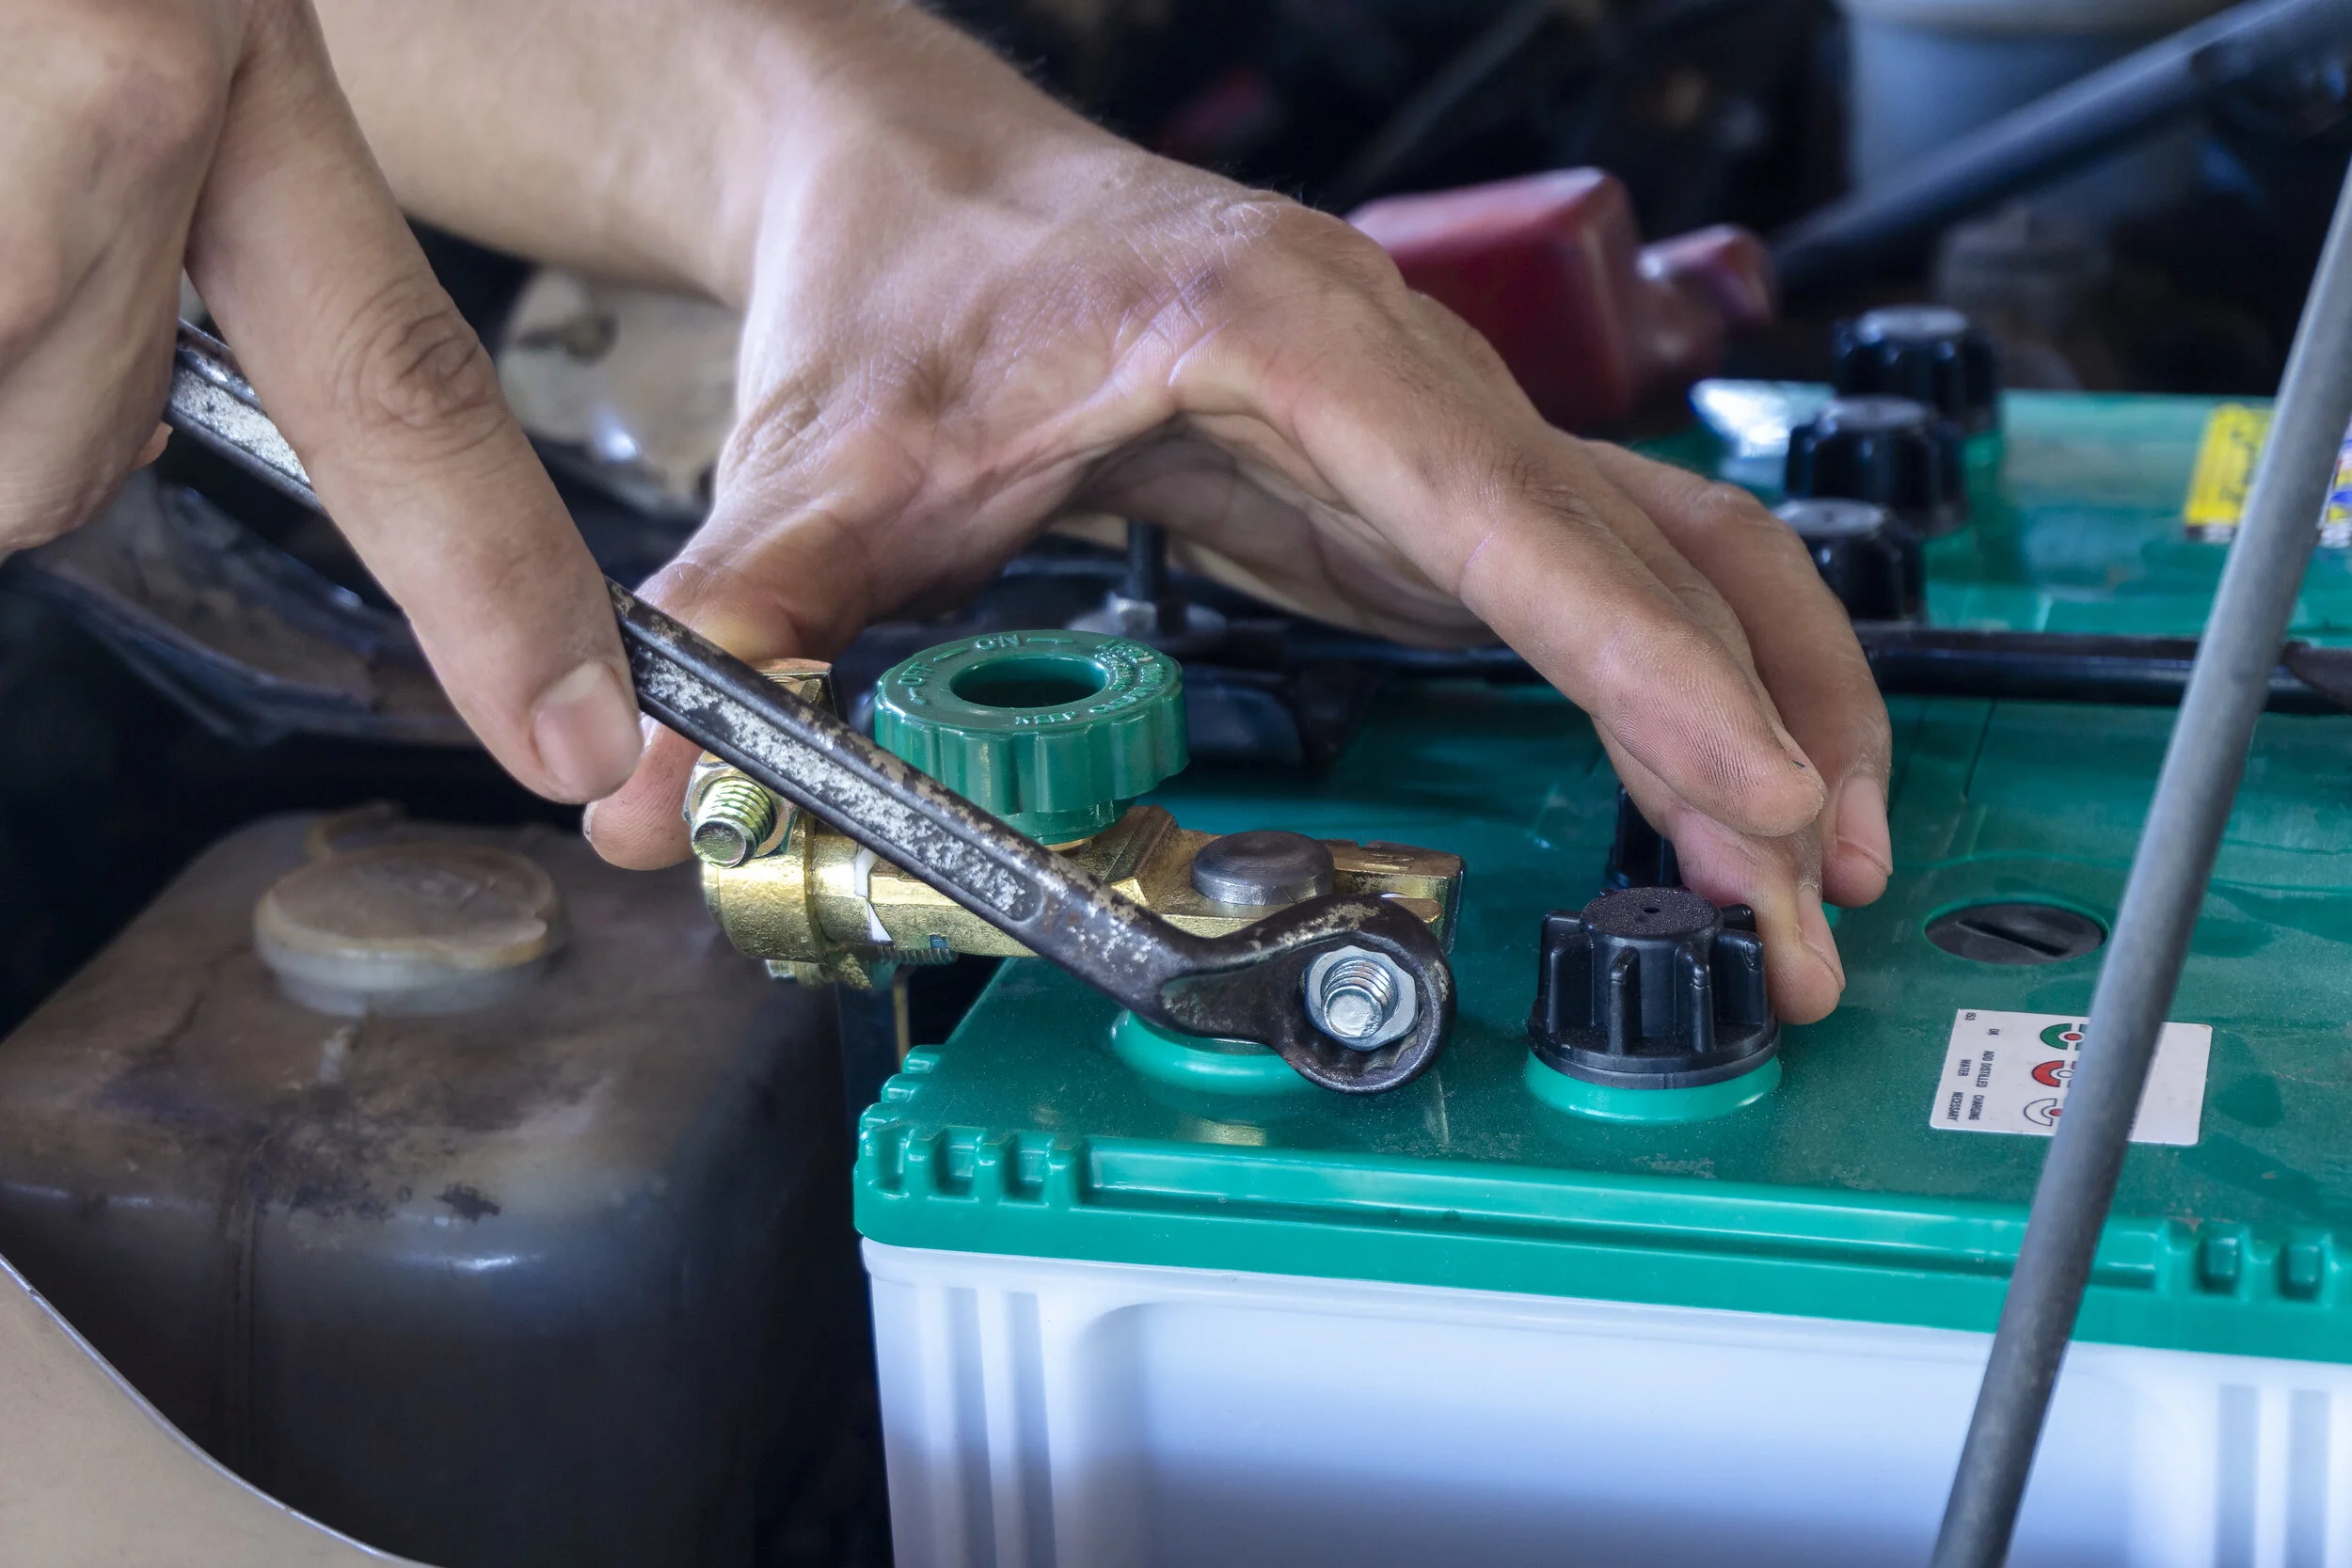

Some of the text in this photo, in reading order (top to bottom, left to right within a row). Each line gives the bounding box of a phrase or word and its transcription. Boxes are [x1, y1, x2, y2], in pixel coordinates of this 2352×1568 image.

[975, 634, 1021, 650] ON
[898, 661, 935, 686] OFF
[1958, 1059, 1972, 1076] WATER
[1976, 1051, 1994, 1087] ADD DISTILLED
[1947, 1092, 1964, 1121] NECESSARY
[1968, 1095, 1985, 1120] CHARGING
